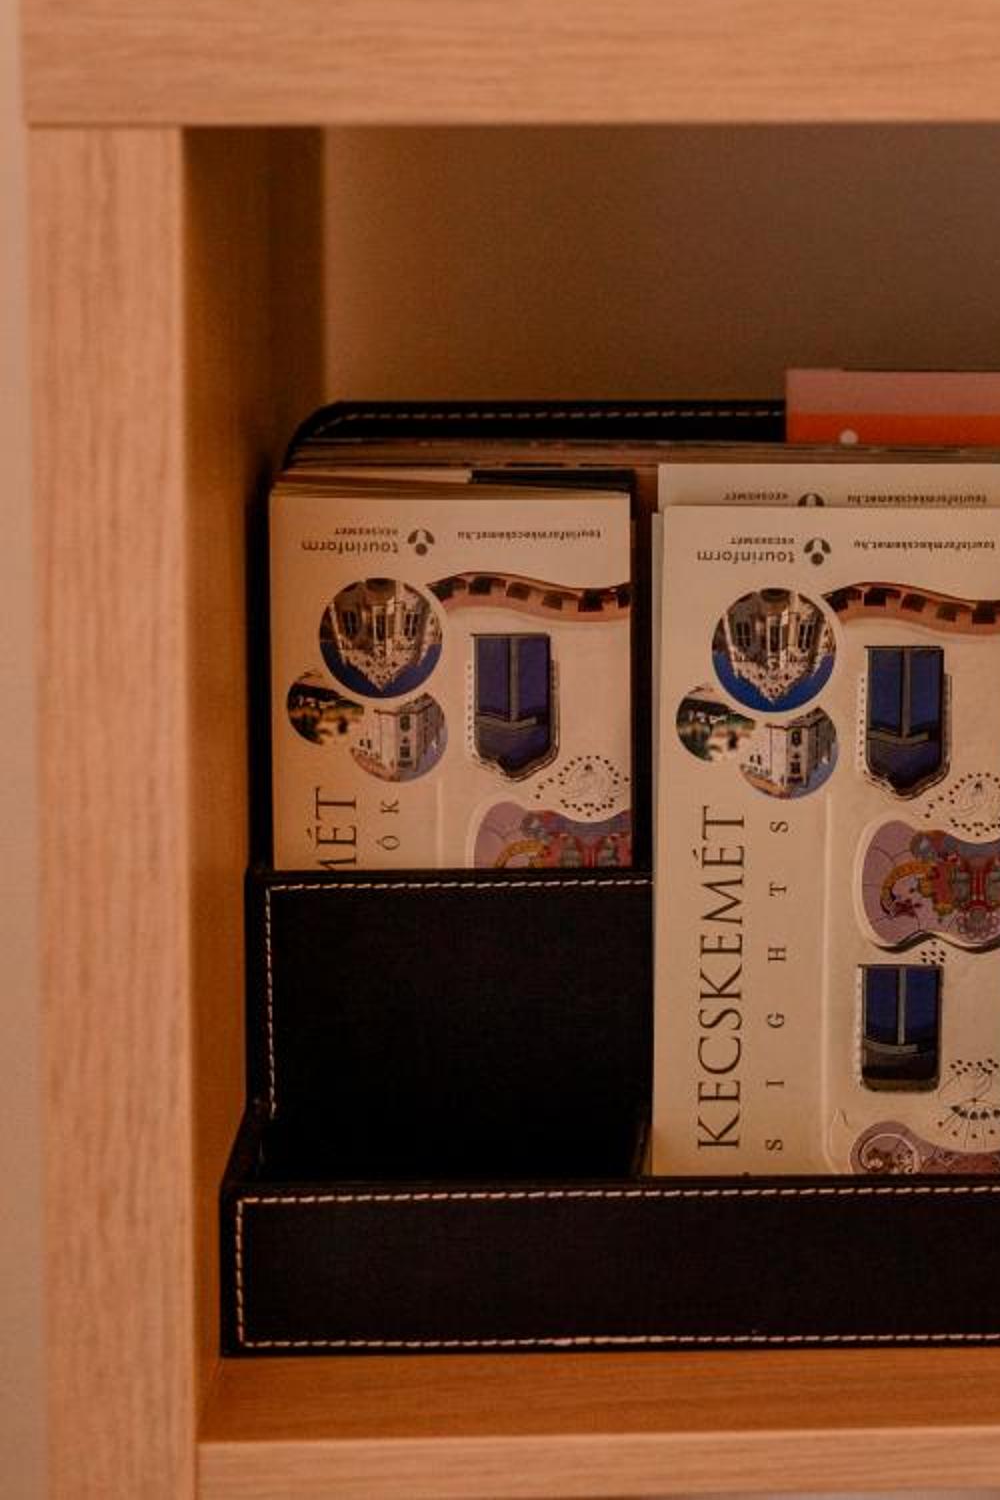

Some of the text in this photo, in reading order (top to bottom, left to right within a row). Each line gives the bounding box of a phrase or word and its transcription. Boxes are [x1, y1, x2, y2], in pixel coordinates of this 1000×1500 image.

[301, 539, 399, 556] tourinform
[697, 550, 796, 566] tourinform
[692, 804, 745, 1150] KECSKEMÉT
[764, 819, 790, 1151] SIGHTS
